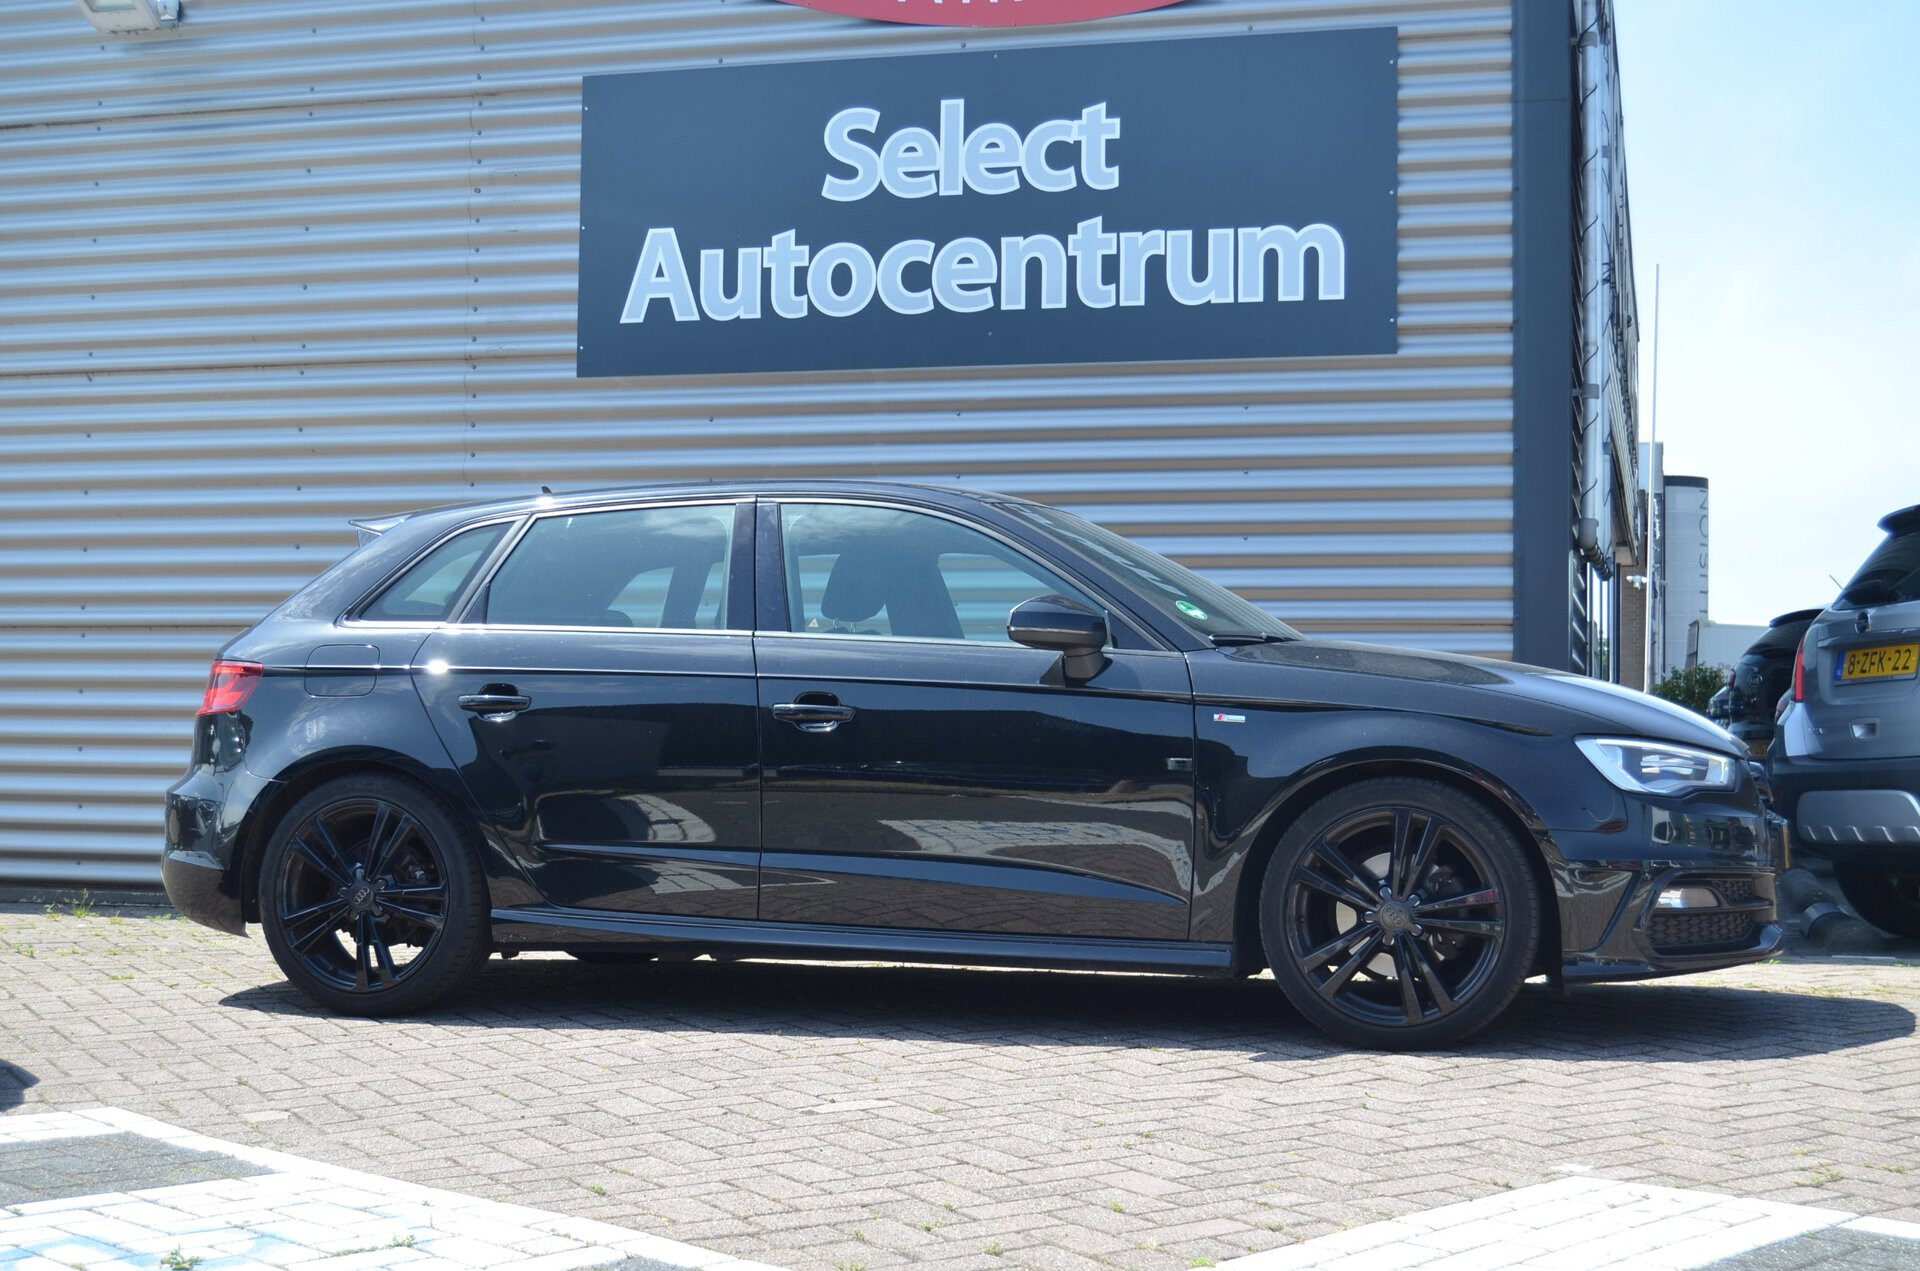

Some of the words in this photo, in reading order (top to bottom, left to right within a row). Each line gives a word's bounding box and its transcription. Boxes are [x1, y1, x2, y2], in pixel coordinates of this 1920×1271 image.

[822, 98, 1120, 201] Select
[620, 217, 1346, 324] Autocentrum
[1848, 648, 1912, 676] 8-ZFK-22
